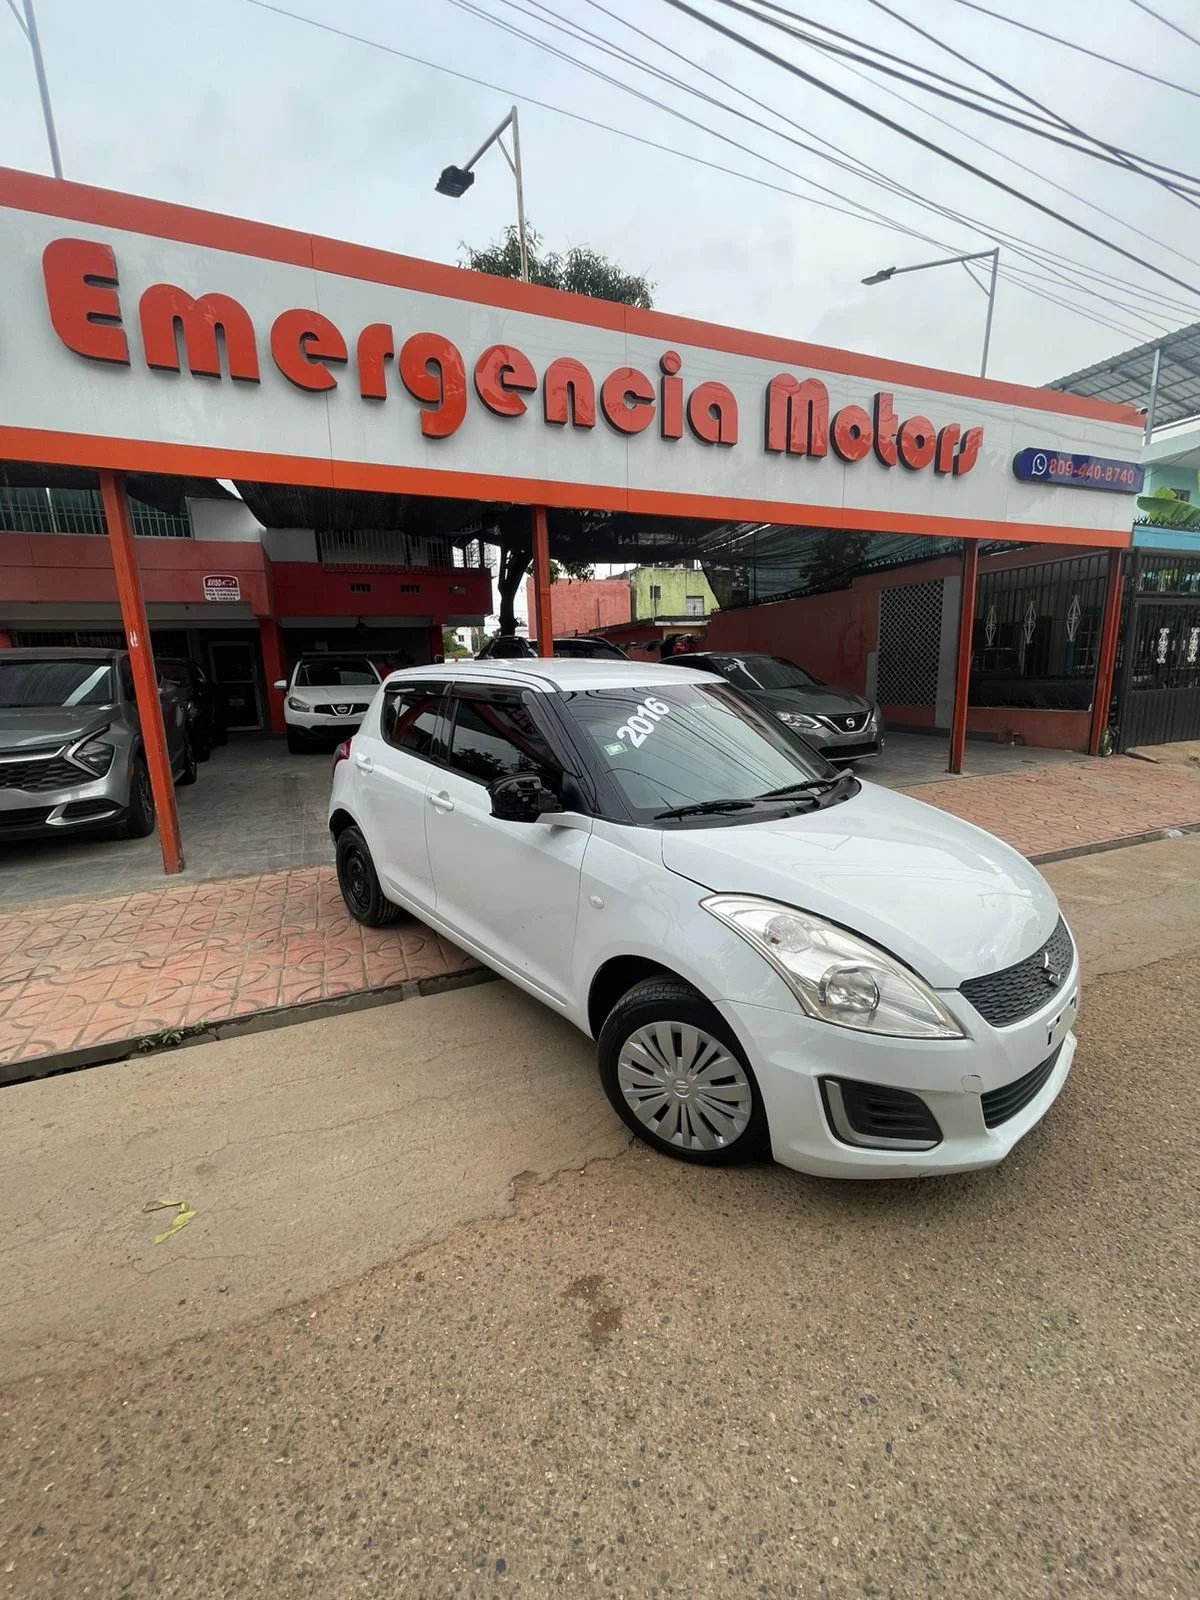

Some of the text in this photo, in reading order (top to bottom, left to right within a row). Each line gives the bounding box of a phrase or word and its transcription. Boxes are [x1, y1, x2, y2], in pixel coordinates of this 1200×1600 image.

[42, 238, 984, 475] Emergencia Motors
[1048, 458, 1135, 484] 809-440-8740
[616, 697, 670, 749] 2016
